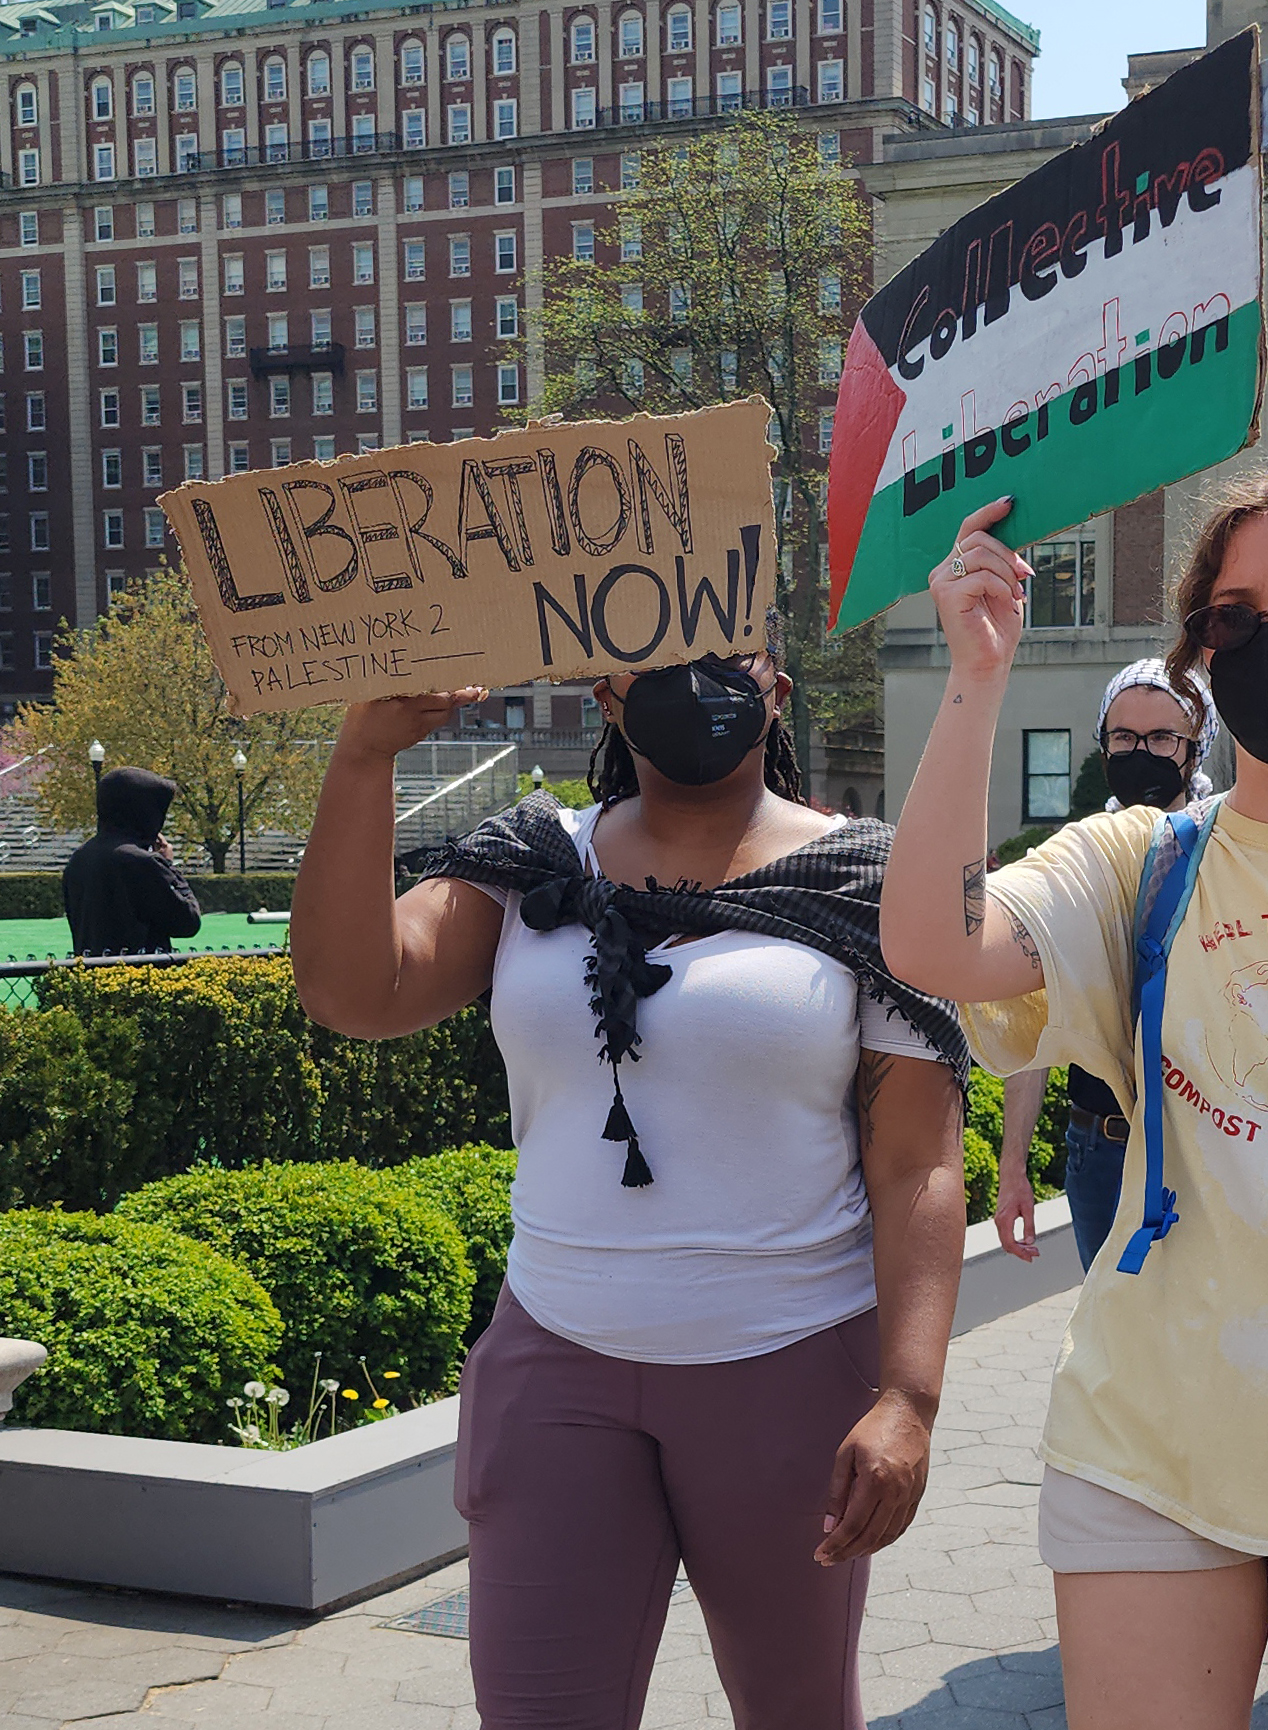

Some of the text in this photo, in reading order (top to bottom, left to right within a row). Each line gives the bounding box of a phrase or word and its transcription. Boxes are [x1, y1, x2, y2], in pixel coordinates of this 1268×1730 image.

[897, 140, 1226, 381] Collective
[901, 291, 1231, 518] Liberation
[191, 432, 694, 614] LIBERATION
[231, 604, 450, 658] FROM NEW YORK 2
[533, 524, 762, 667] NOW!
[251, 648, 412, 695] PALESTINE
[1161, 1054, 1262, 1143] COMPOST
